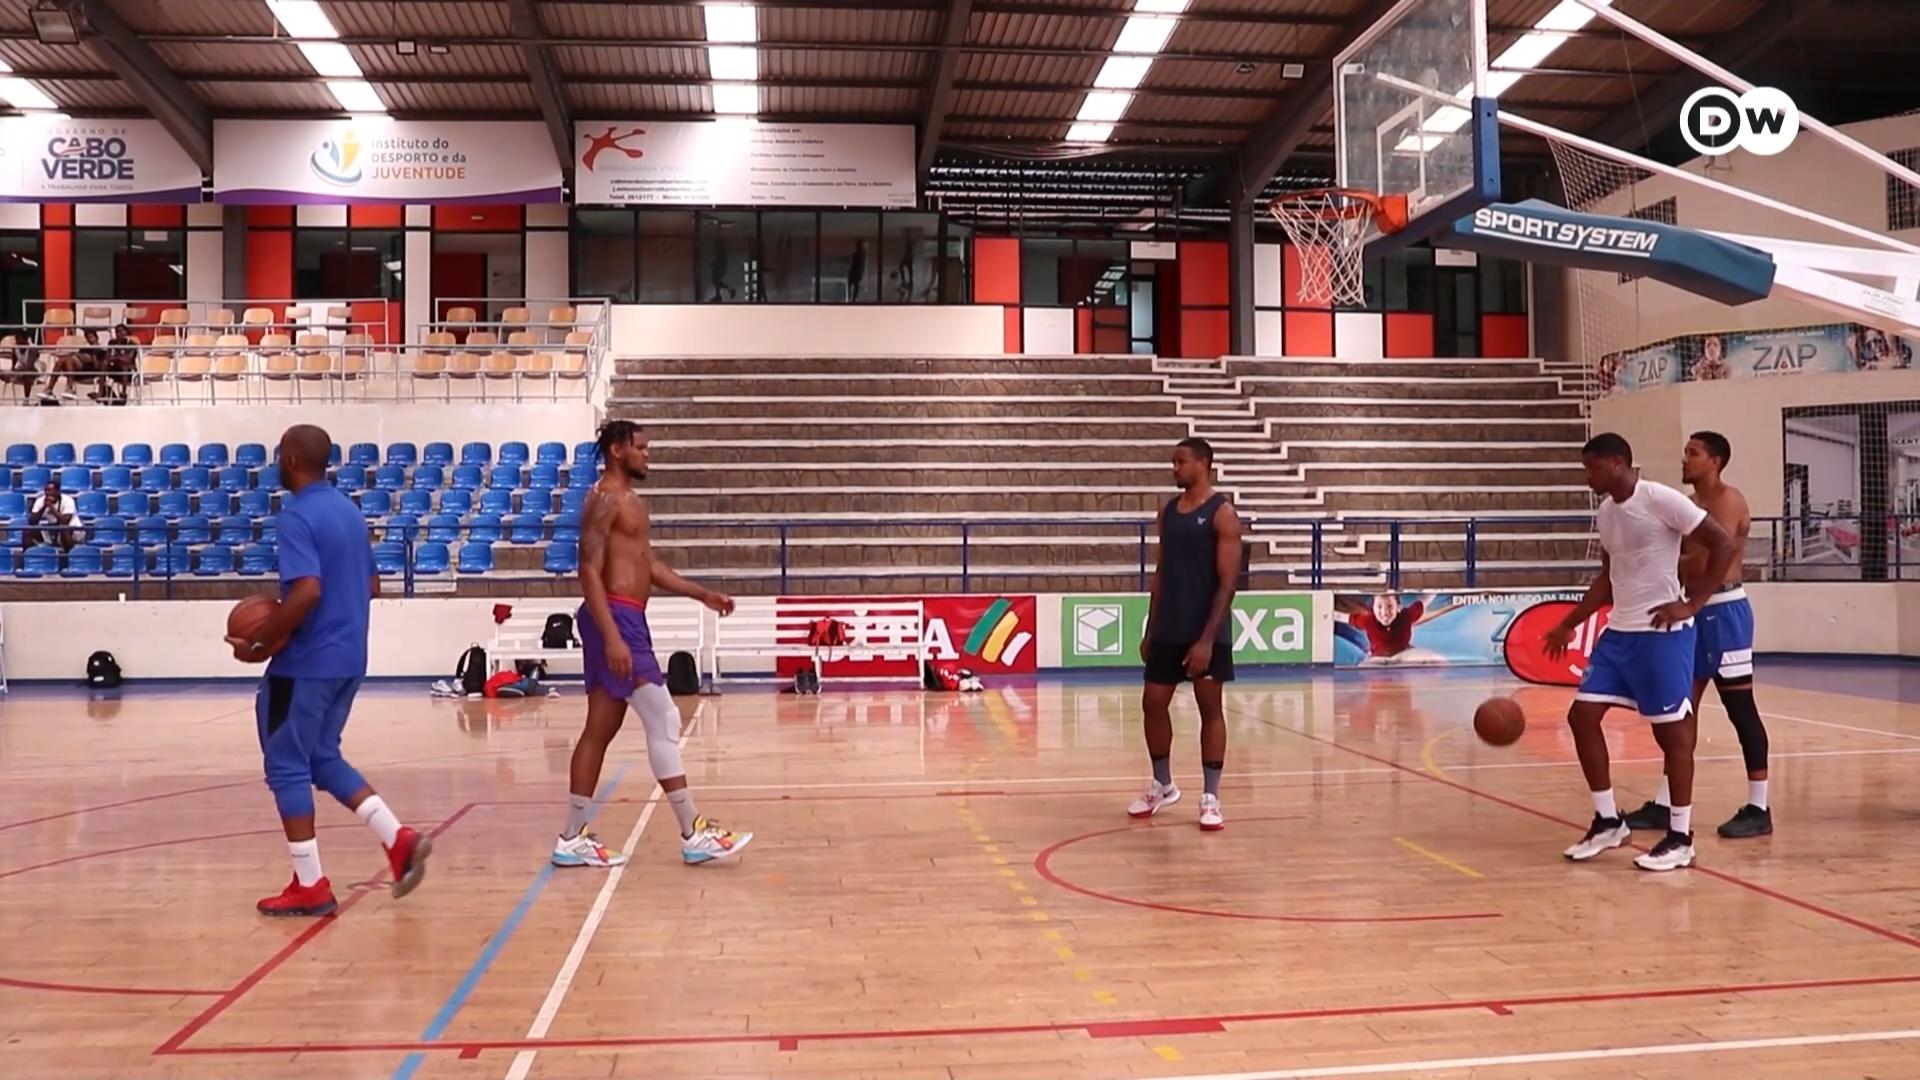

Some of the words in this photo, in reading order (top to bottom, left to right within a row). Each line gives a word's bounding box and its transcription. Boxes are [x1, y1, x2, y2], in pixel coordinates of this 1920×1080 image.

[47, 136, 127, 159] CABO
[371, 137, 429, 149] Instituto
[432, 137, 449, 149] do
[371, 152, 439, 163] DESPORTO
[441, 154, 449, 163] e
[452, 152, 467, 163] da
[41, 158, 135, 180] VERDE
[371, 166, 466, 179] JUVENTUDE
[1752, 343, 1818, 371] ZAP
[1638, 356, 1669, 383] ZAP
[1453, 595, 1487, 605] ENTRA
[1558, 592, 1585, 602] FANT
